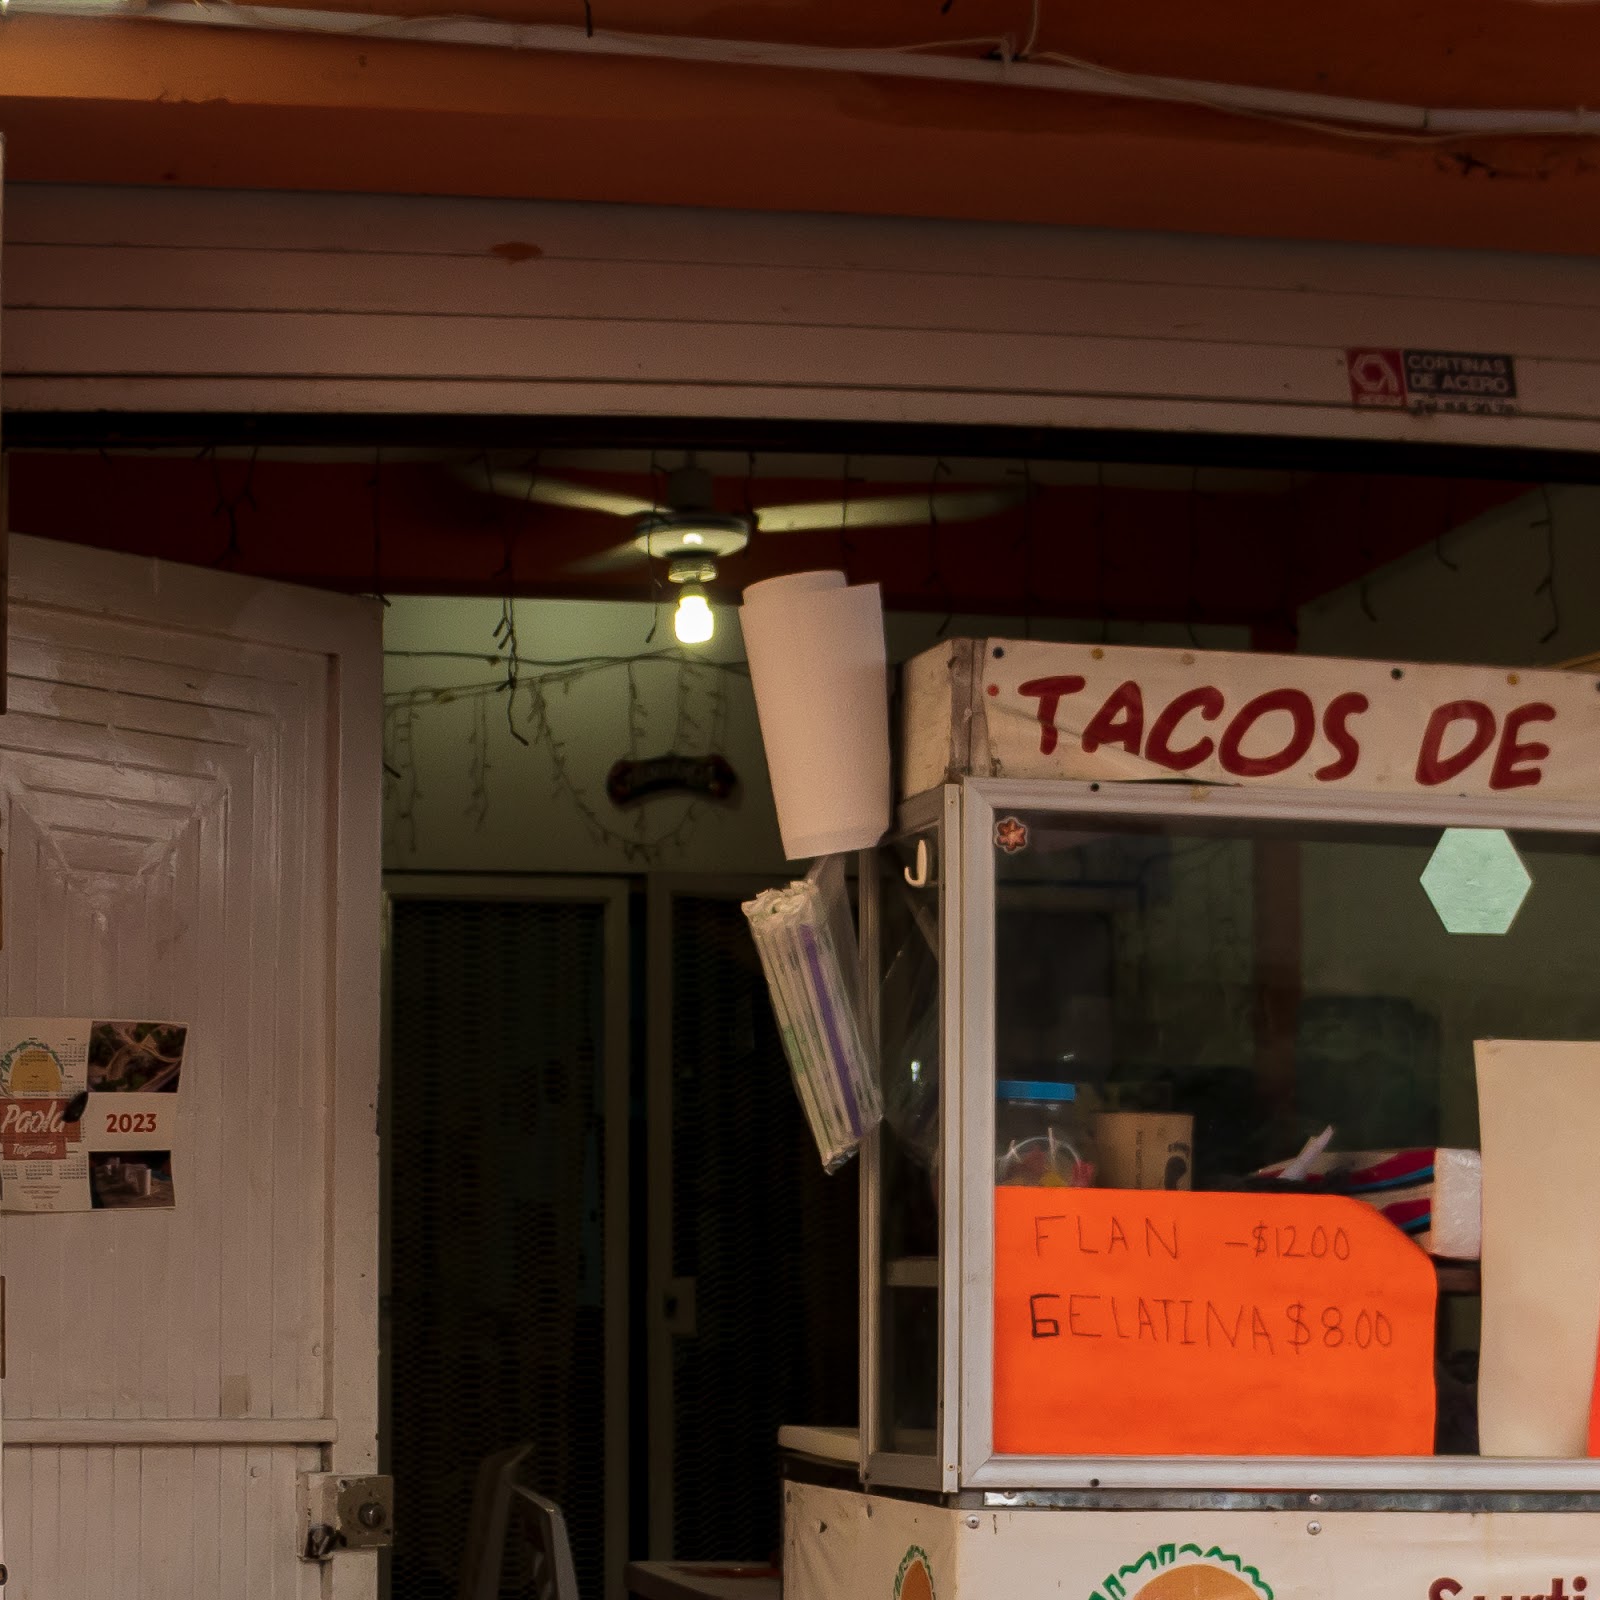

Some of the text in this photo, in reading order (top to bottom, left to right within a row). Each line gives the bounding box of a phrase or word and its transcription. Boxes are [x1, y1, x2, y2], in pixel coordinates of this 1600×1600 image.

[1019, 675, 1369, 784] TACOS
[1414, 698, 1557, 791] DE
[106, 1113, 158, 1133] 2023
[1033, 1215, 1180, 1260] FLAN
